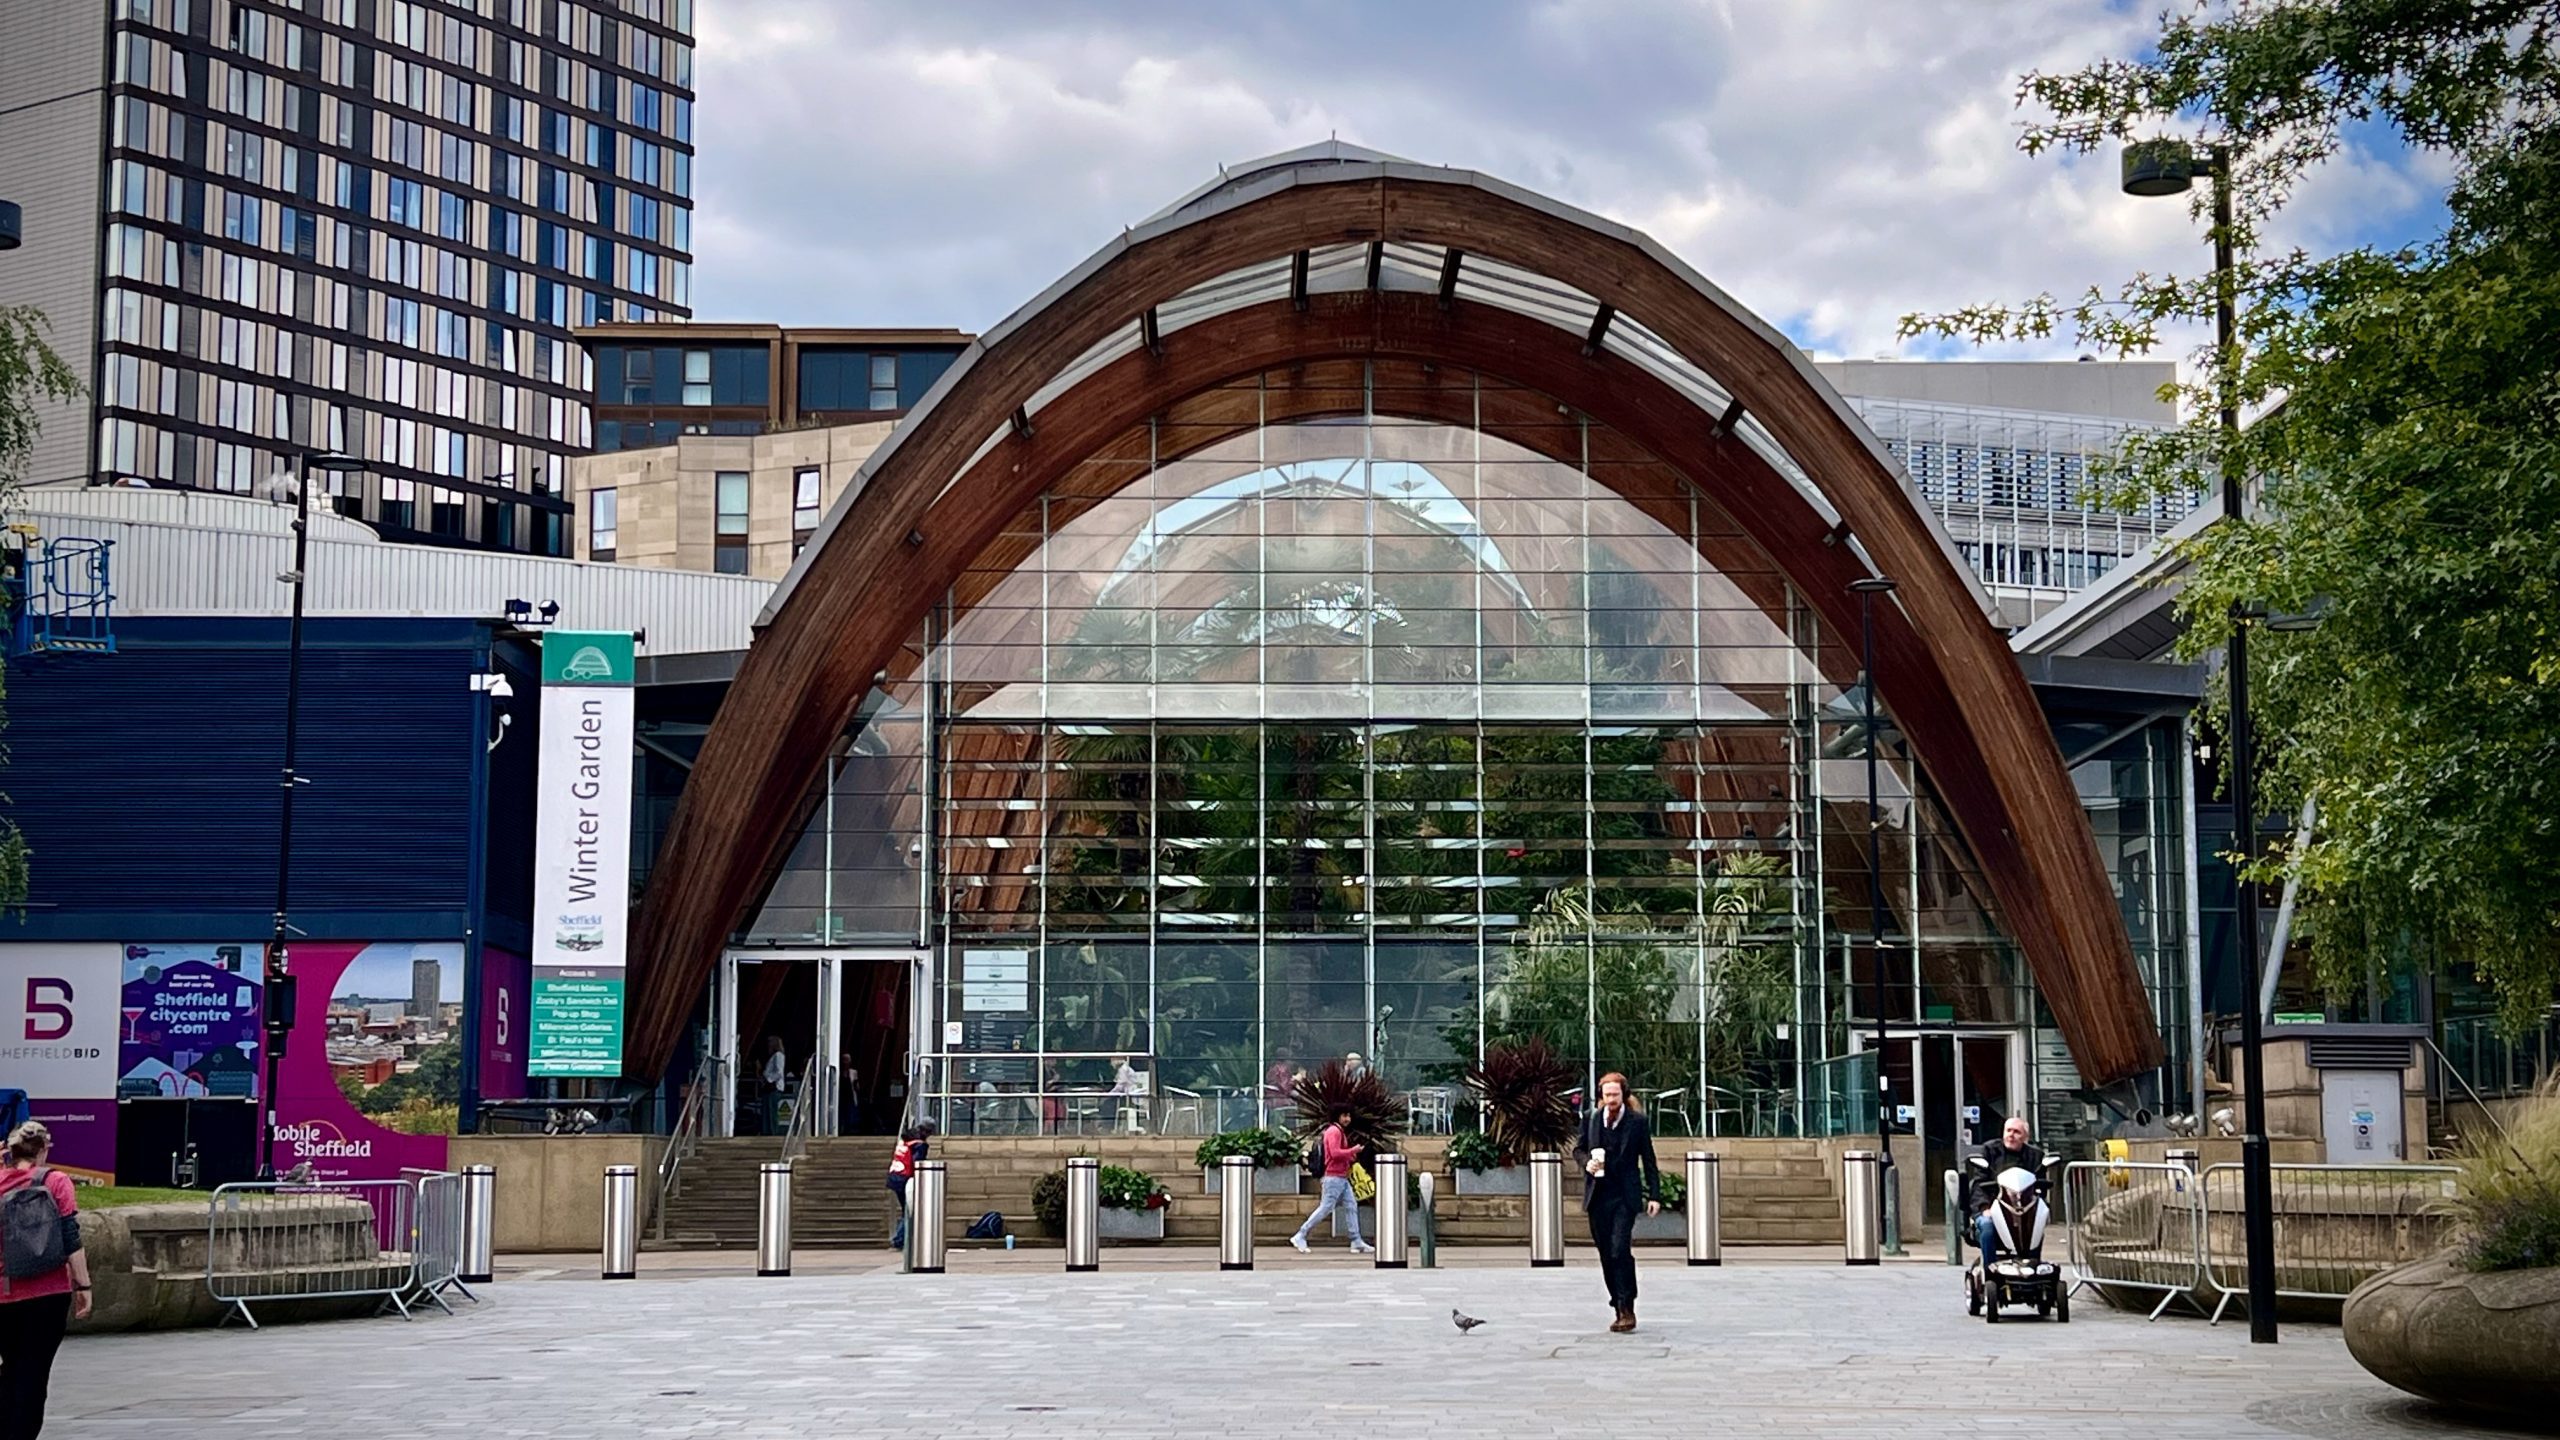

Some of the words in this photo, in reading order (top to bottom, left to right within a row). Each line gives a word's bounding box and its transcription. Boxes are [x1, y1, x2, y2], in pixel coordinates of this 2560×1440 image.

[572, 700, 602, 800] Garden
[568, 808, 599, 903] Winter
[559, 914, 602, 925] Sheffield
[154, 992, 227, 1006] Sheffield
[150, 1007, 231, 1024] citycentre
[168, 1024, 208, 1034] .com
[0, 1047, 100, 1059] HEFFIELDBID
[68, 1114, 95, 1122] District
[293, 1140, 371, 1157] Sheffield
